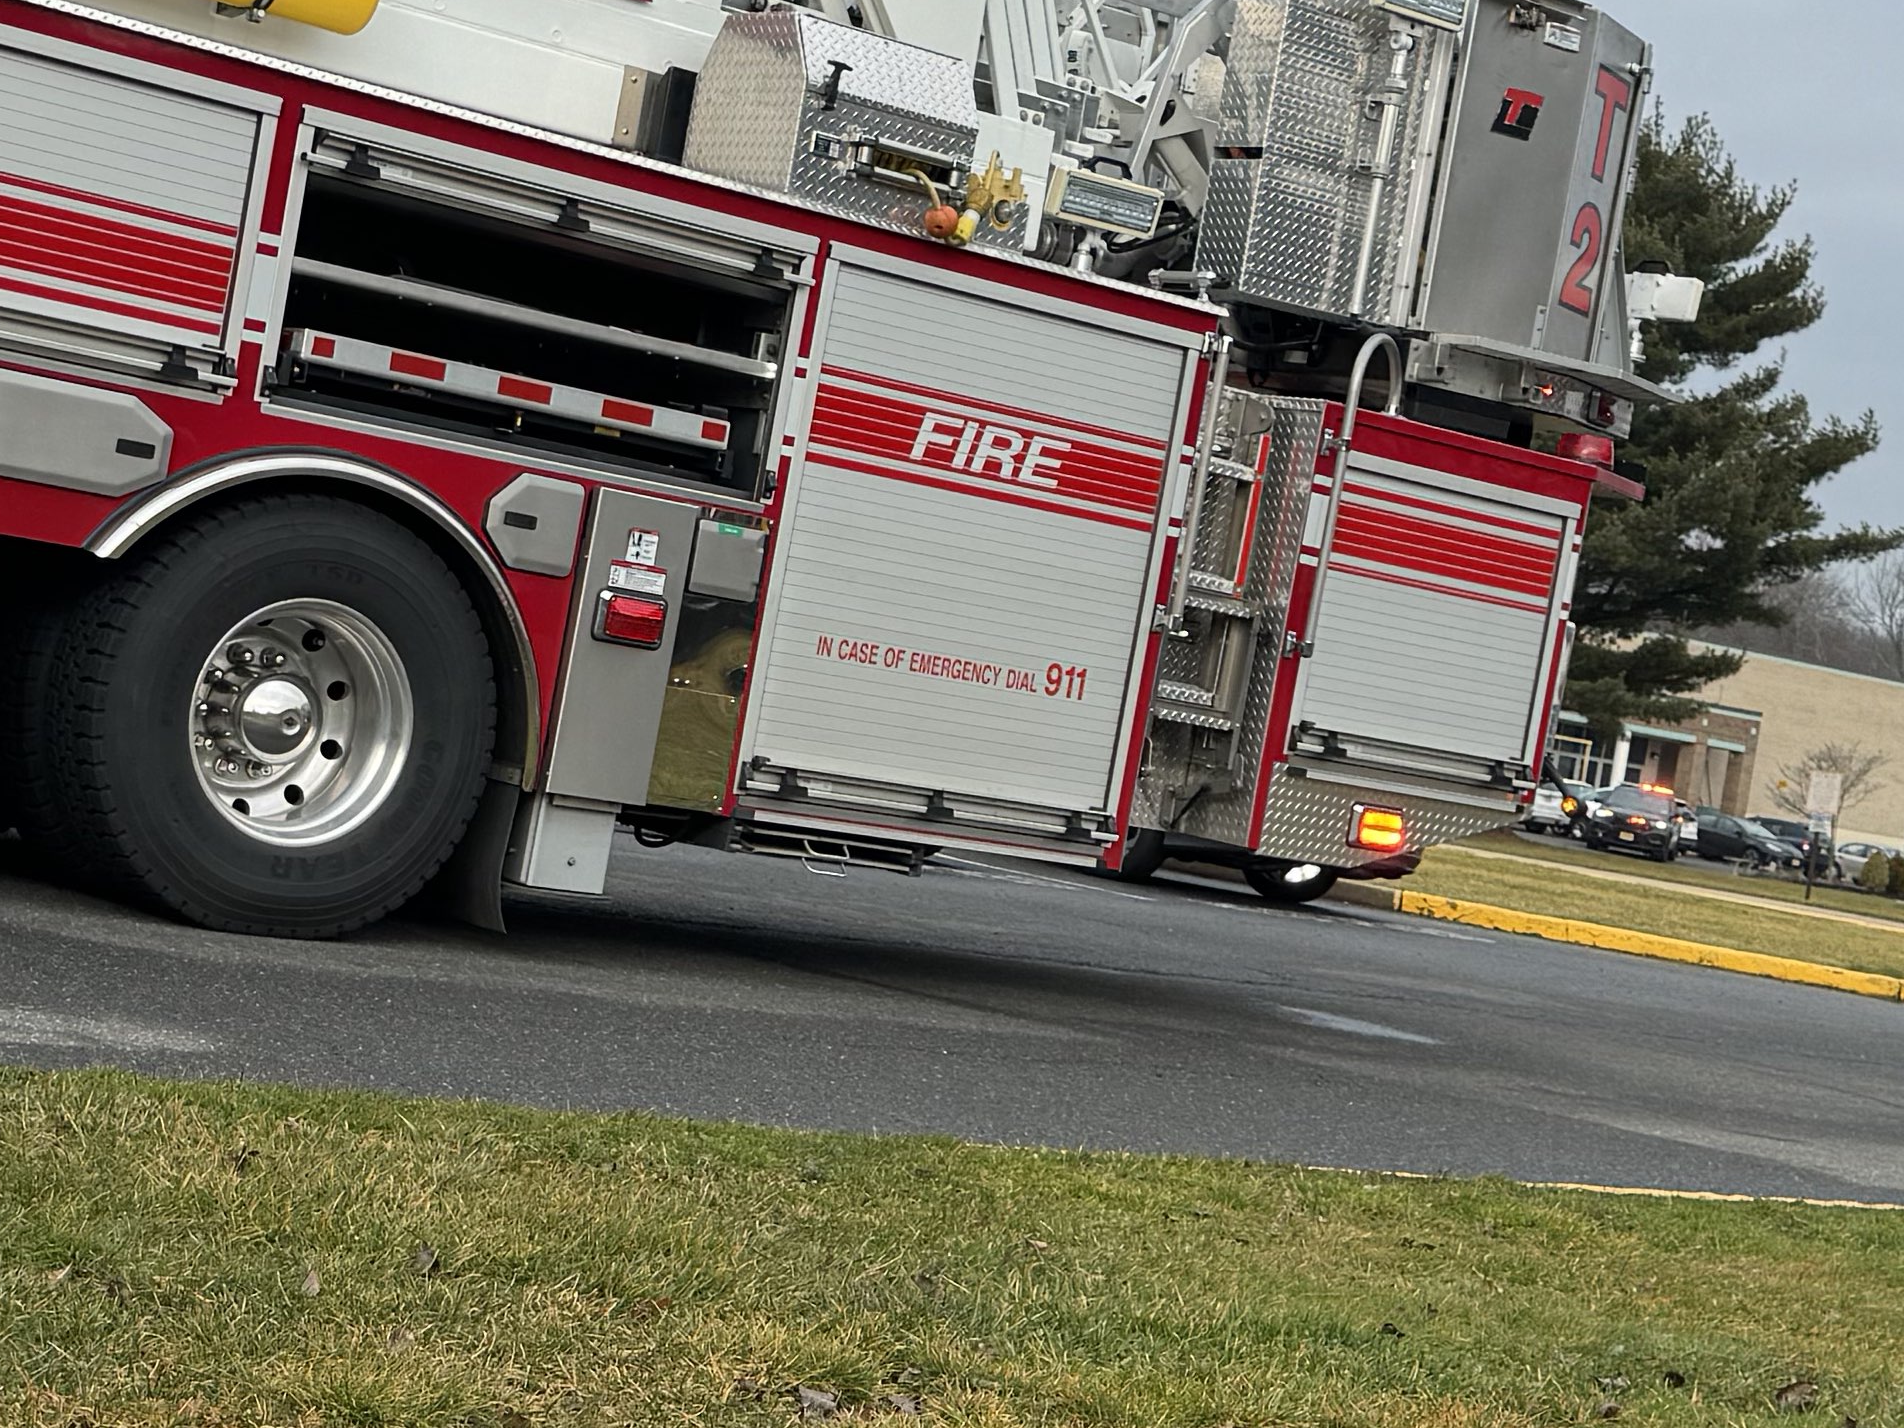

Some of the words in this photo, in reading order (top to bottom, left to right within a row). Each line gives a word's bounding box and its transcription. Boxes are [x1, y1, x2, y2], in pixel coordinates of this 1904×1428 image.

[909, 411, 1073, 489] FIRE
[815, 635, 834, 659] IN
[837, 638, 880, 666] CASE
[883, 646, 907, 670] OF
[909, 652, 1002, 687] EMERGENCY
[1005, 668, 1038, 694] DIAL
[1043, 662, 1088, 701] 911
